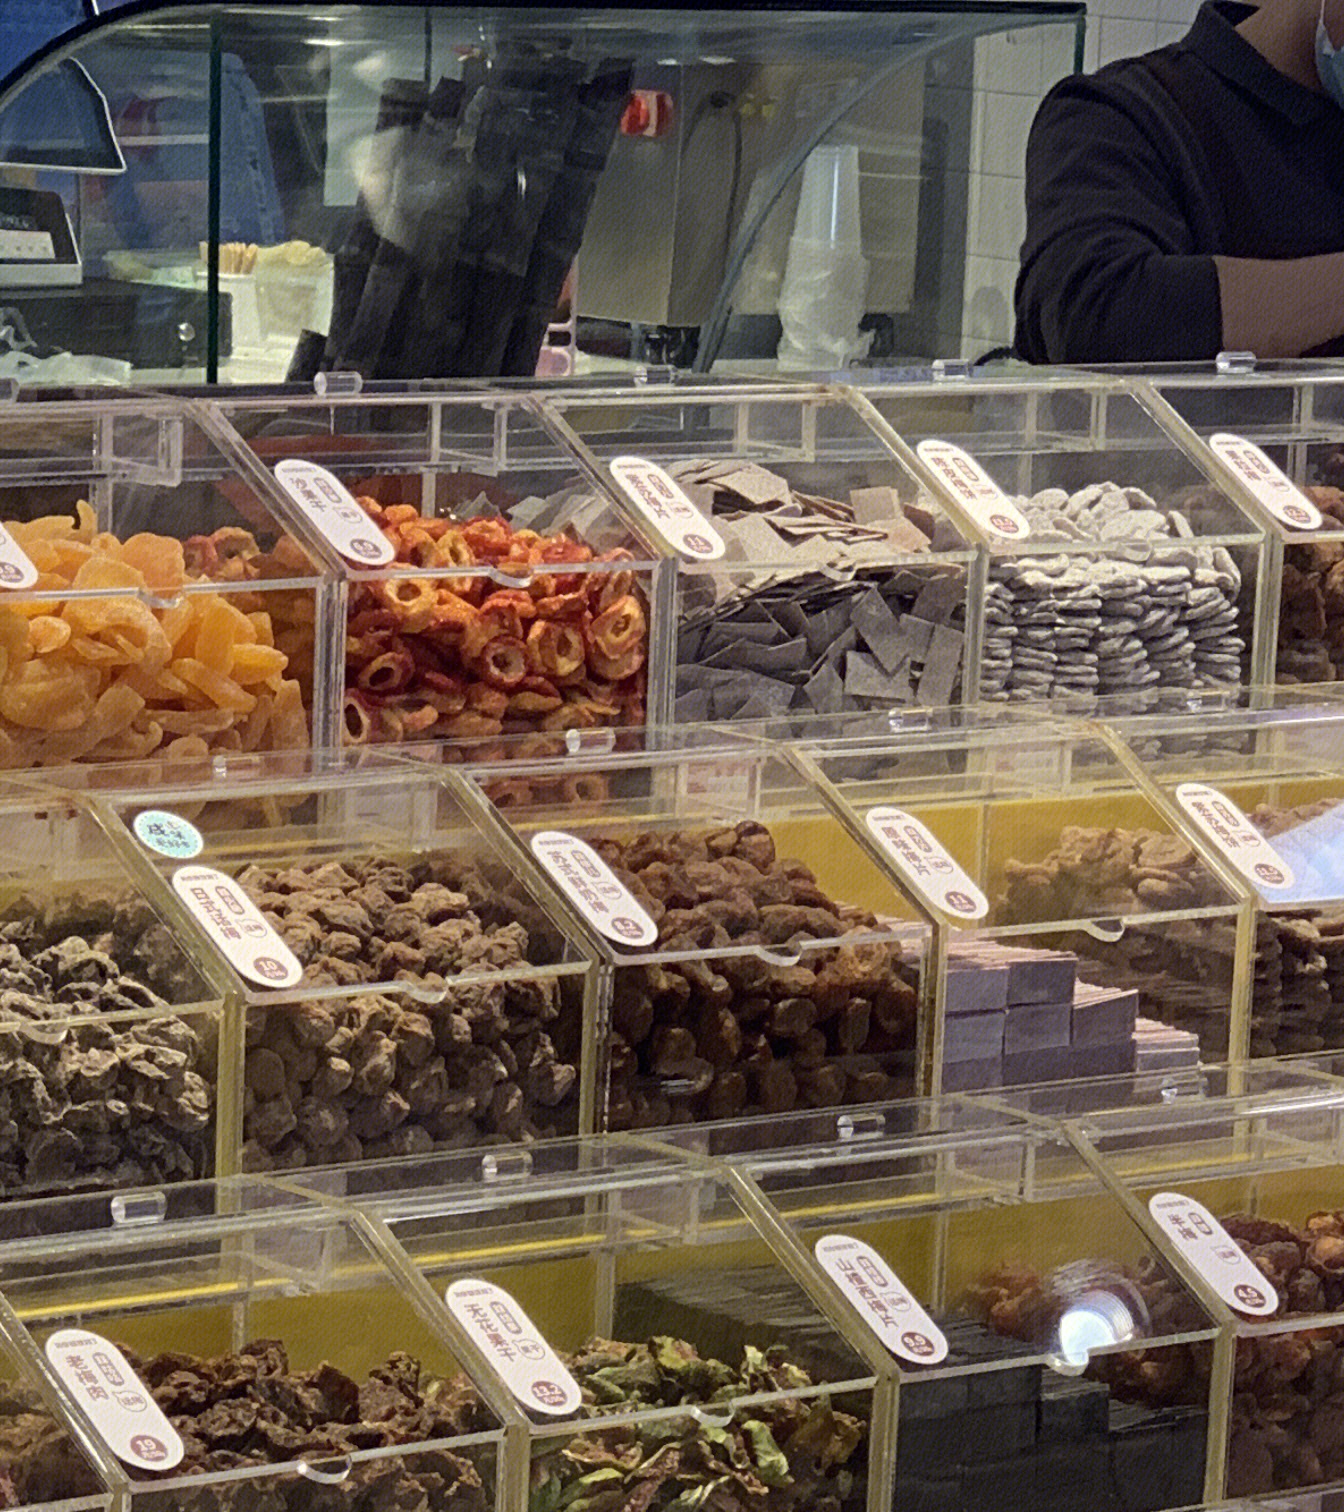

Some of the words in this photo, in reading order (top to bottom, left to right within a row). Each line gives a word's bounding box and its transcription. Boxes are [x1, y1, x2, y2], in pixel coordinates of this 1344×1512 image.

[191, 887, 241, 940] 日式话梅
[464, 1303, 516, 1362] 无花果干
[66, 1354, 109, 1401] 老梅肉
[135, 1440, 157, 1451] 19
